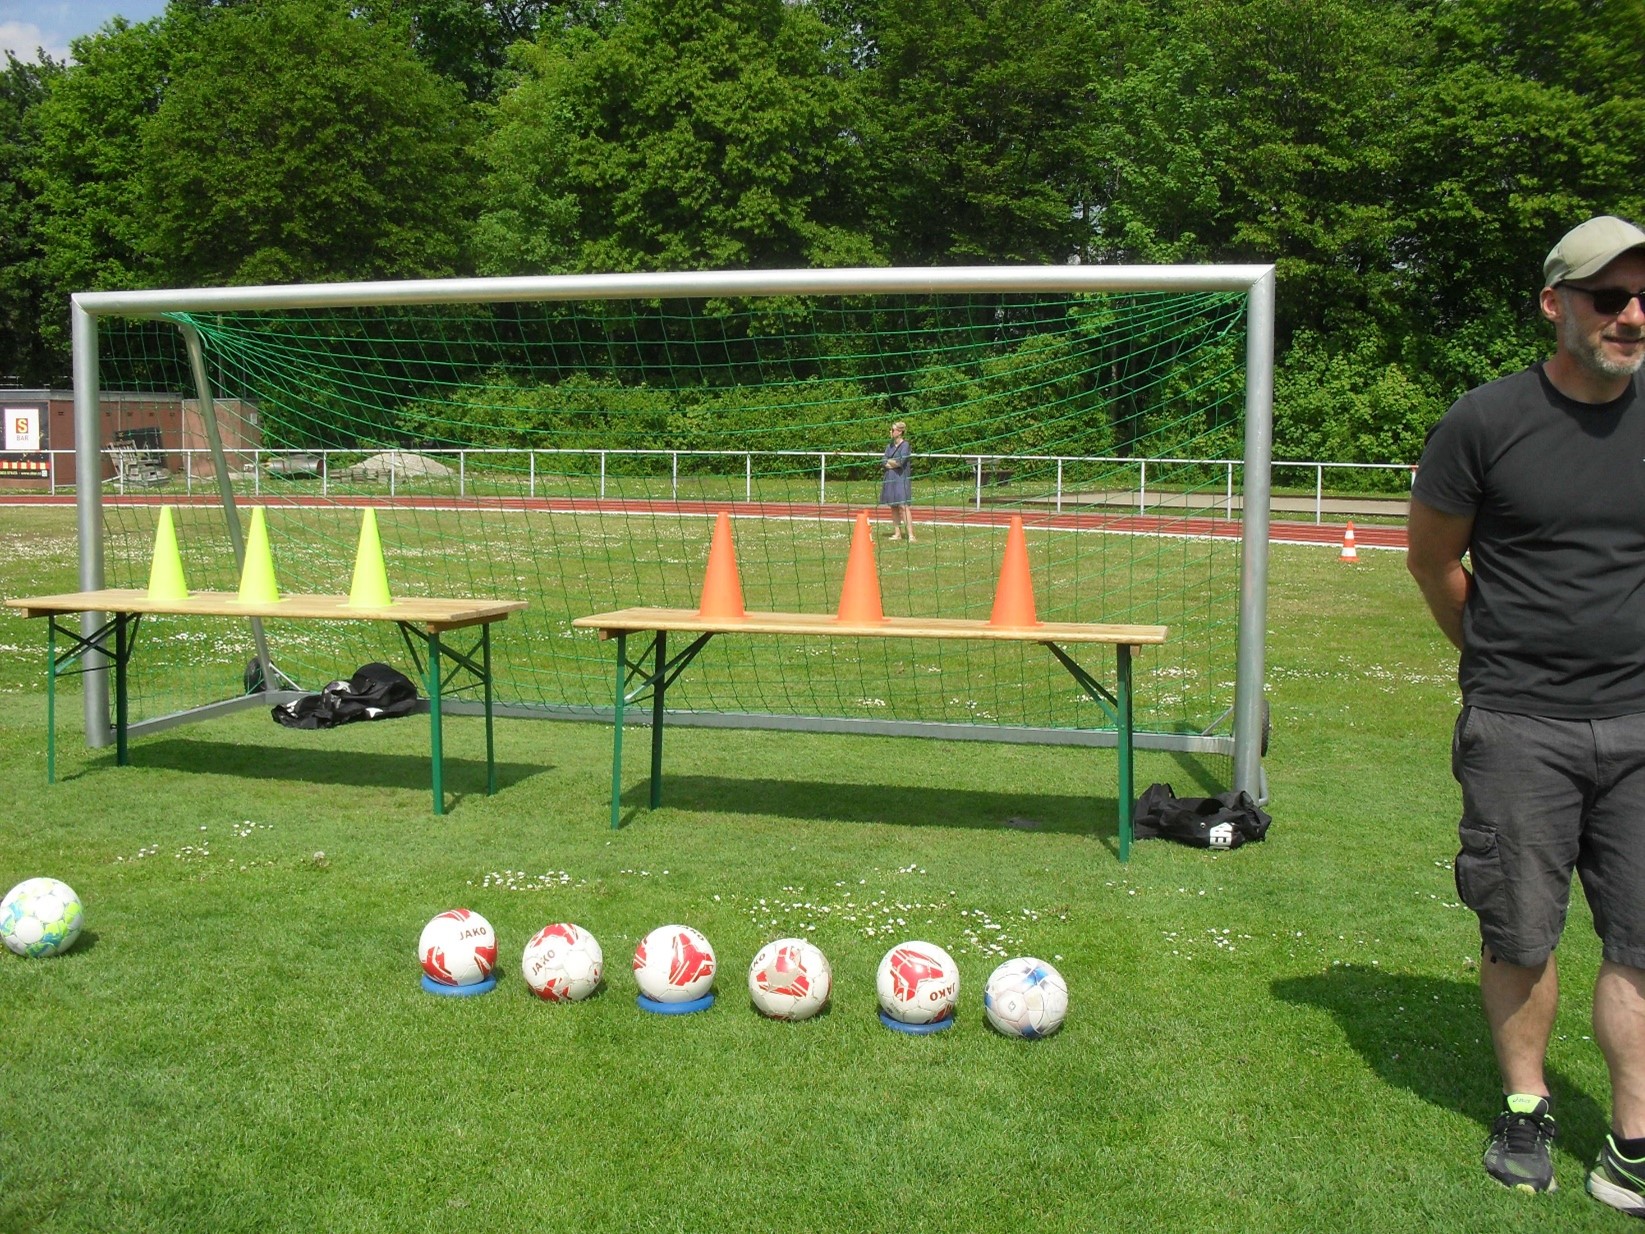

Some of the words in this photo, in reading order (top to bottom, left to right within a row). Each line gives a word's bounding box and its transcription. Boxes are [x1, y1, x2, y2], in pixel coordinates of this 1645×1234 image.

[17, 418, 28, 433] S
[459, 926, 487, 941] JAKO
[532, 949, 555, 976] JAKO
[929, 982, 955, 1001] JAKO
